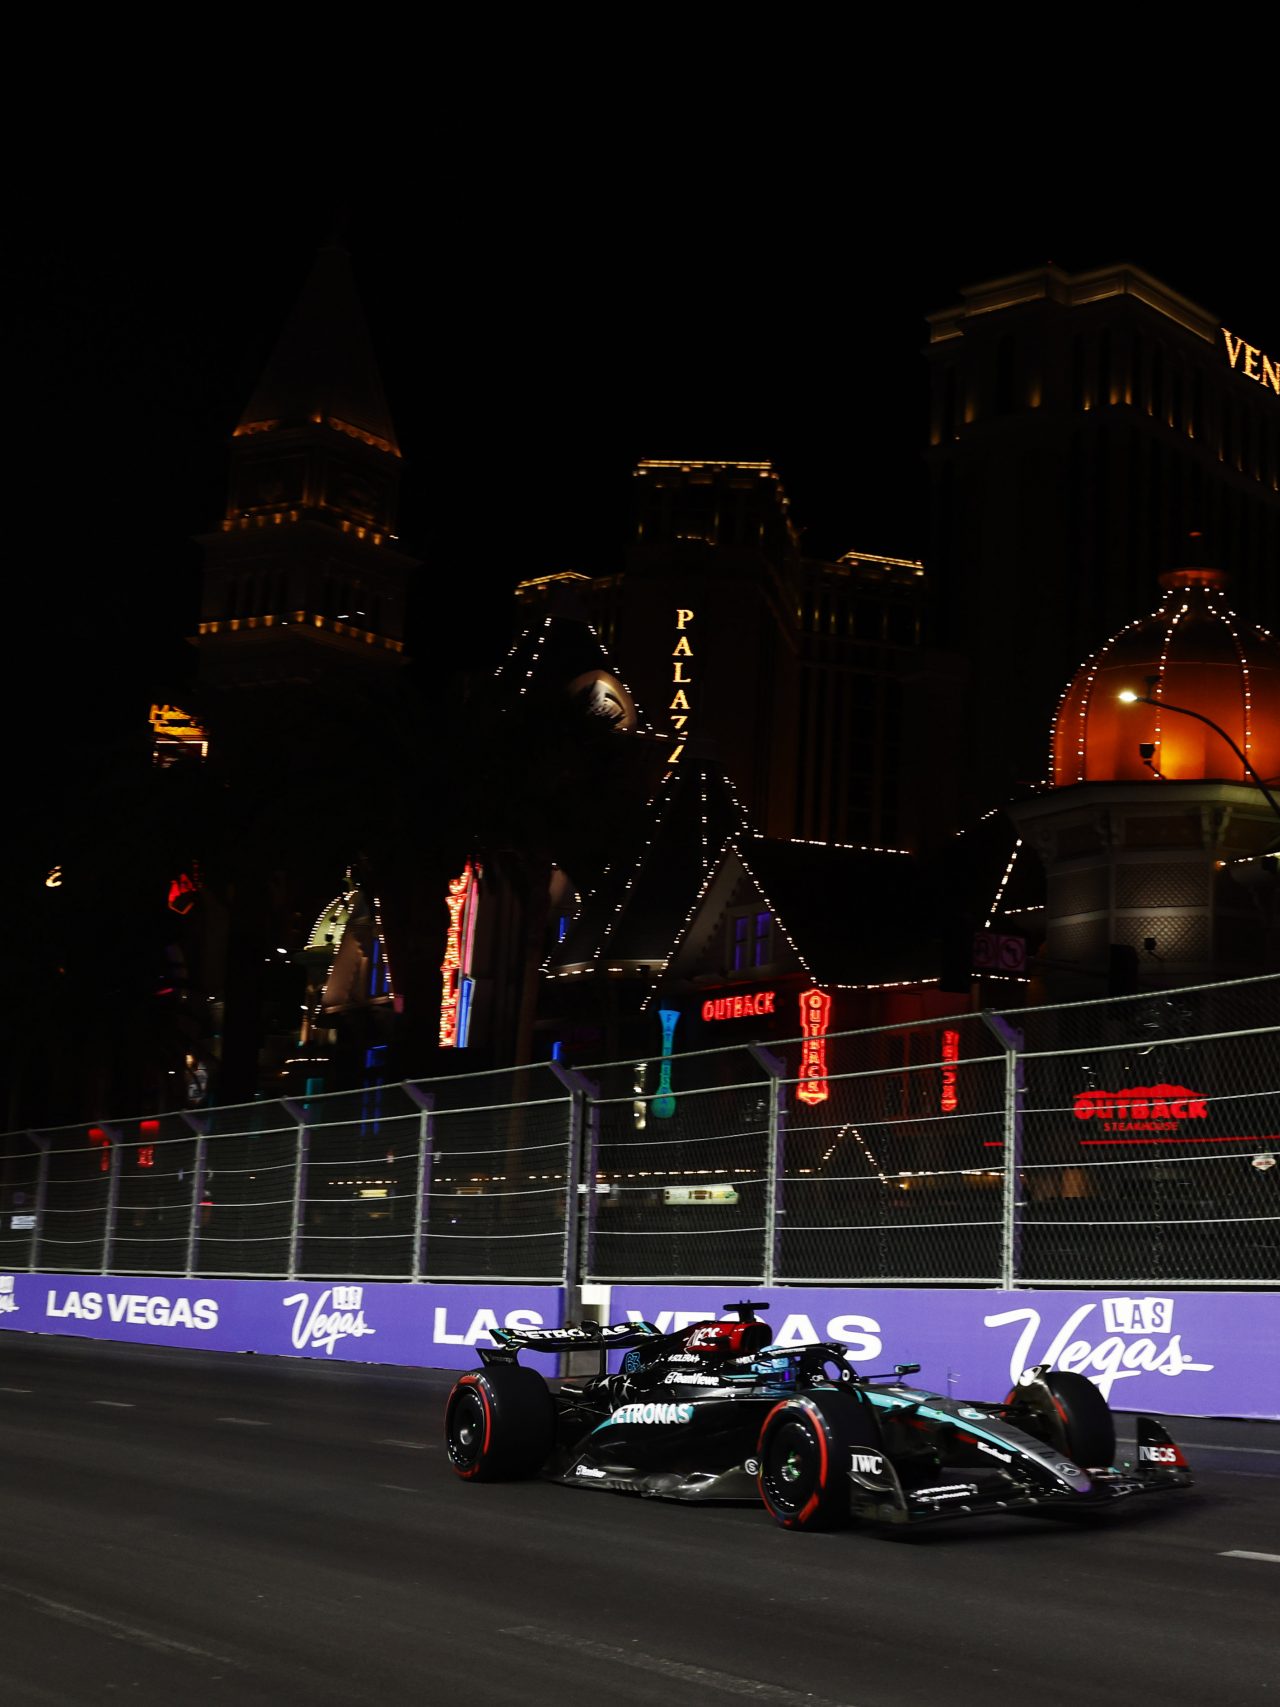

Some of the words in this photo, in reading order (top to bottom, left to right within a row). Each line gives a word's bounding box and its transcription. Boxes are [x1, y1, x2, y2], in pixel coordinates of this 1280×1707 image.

[702, 991, 776, 1022] OUTBACK
[808, 995, 823, 1092] OUTBACK
[1074, 1098, 1208, 1120] OUTBACK
[1103, 1121, 1178, 1132] STEAKHOUSE
[46, 1290, 102, 1320] LAS
[107, 1292, 218, 1330] VEGAS
[283, 1289, 376, 1355] Vegas
[1111, 1301, 1166, 1330] LAS
[984, 1304, 1214, 1403] Vegas
[611, 1403, 690, 1424] PETRONAS
[851, 1454, 882, 1474] IWC
